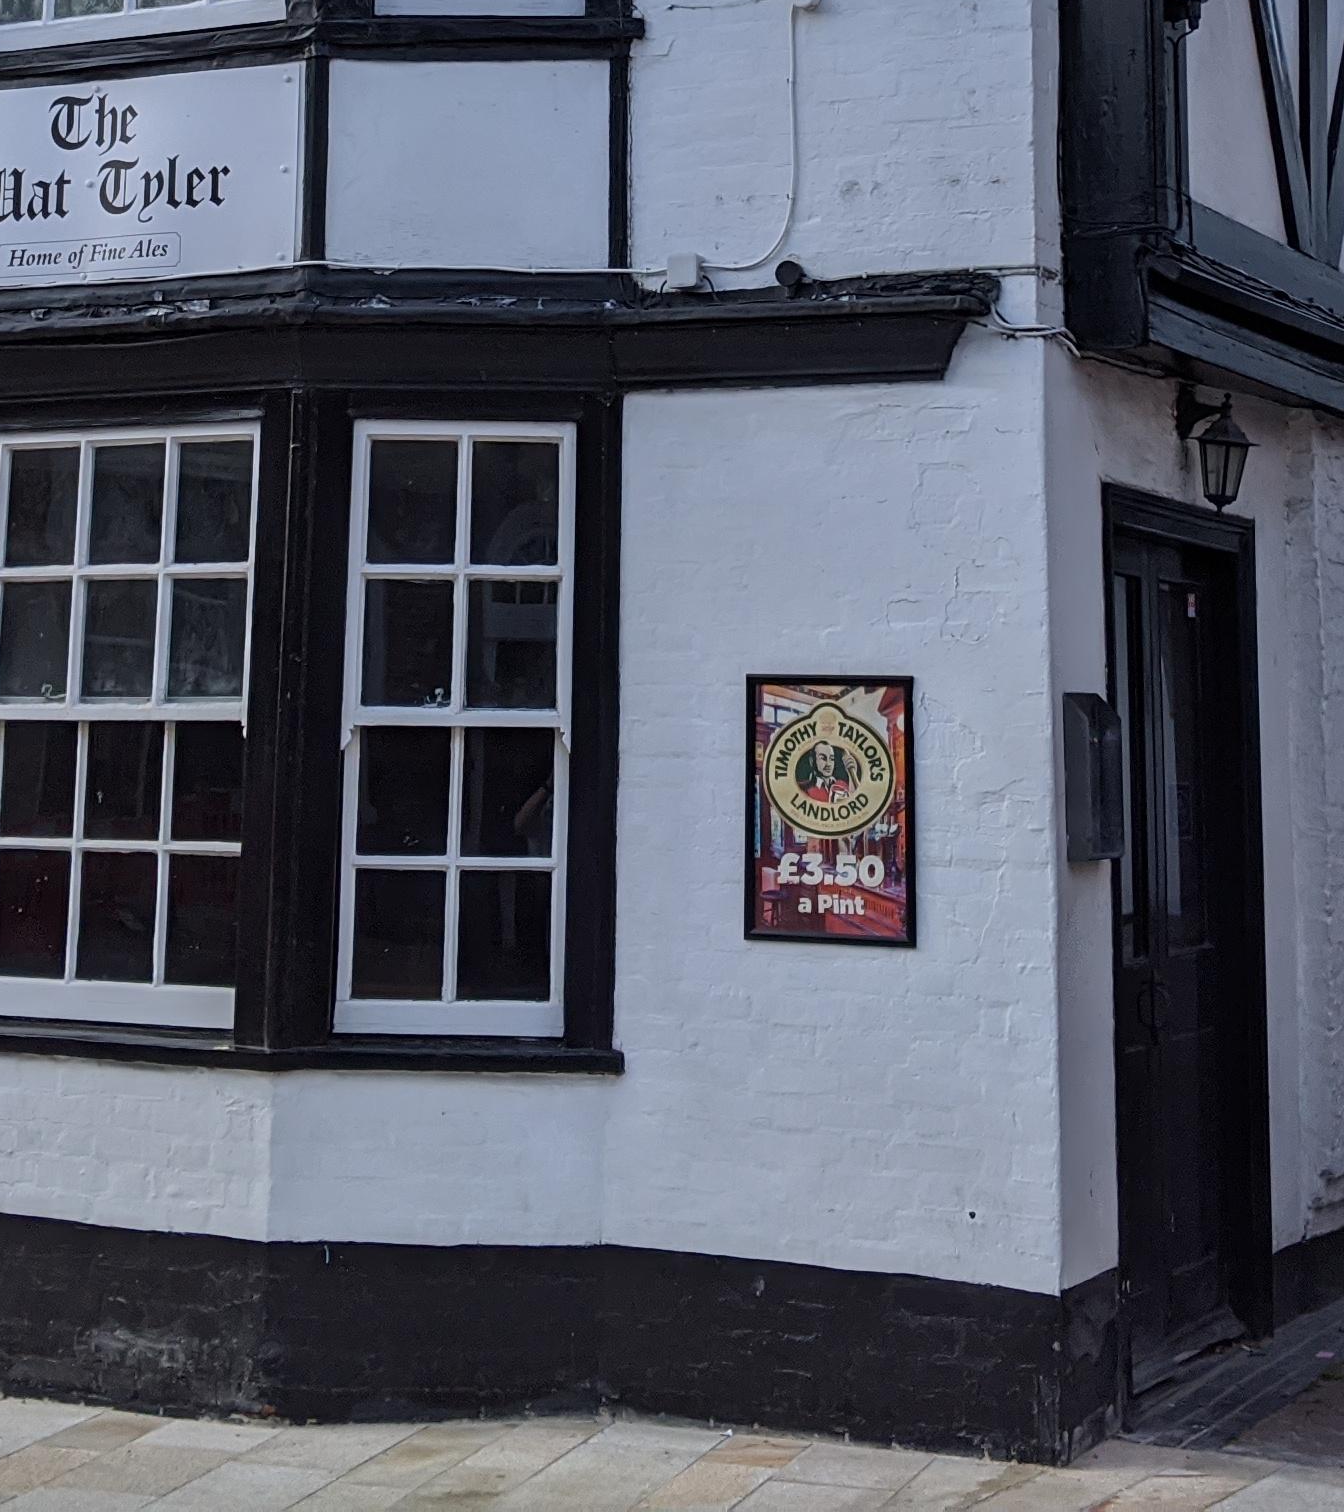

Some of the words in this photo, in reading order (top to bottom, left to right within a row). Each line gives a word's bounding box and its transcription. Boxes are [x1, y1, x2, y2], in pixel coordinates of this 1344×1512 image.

[49, 93, 138, 156] The
[97, 154, 231, 223] Tyler
[8, 247, 62, 268] Home
[68, 244, 85, 268] of
[90, 242, 126, 263] Fine
[130, 239, 168, 260] Ales
[774, 721, 818, 780] TIMOTHY
[838, 722, 884, 782] TAYLOR'S
[790, 793, 869, 821] LANDLORD
[777, 853, 885, 887] £3.50
[798, 898, 811, 914] a
[818, 895, 865, 915] Pint
